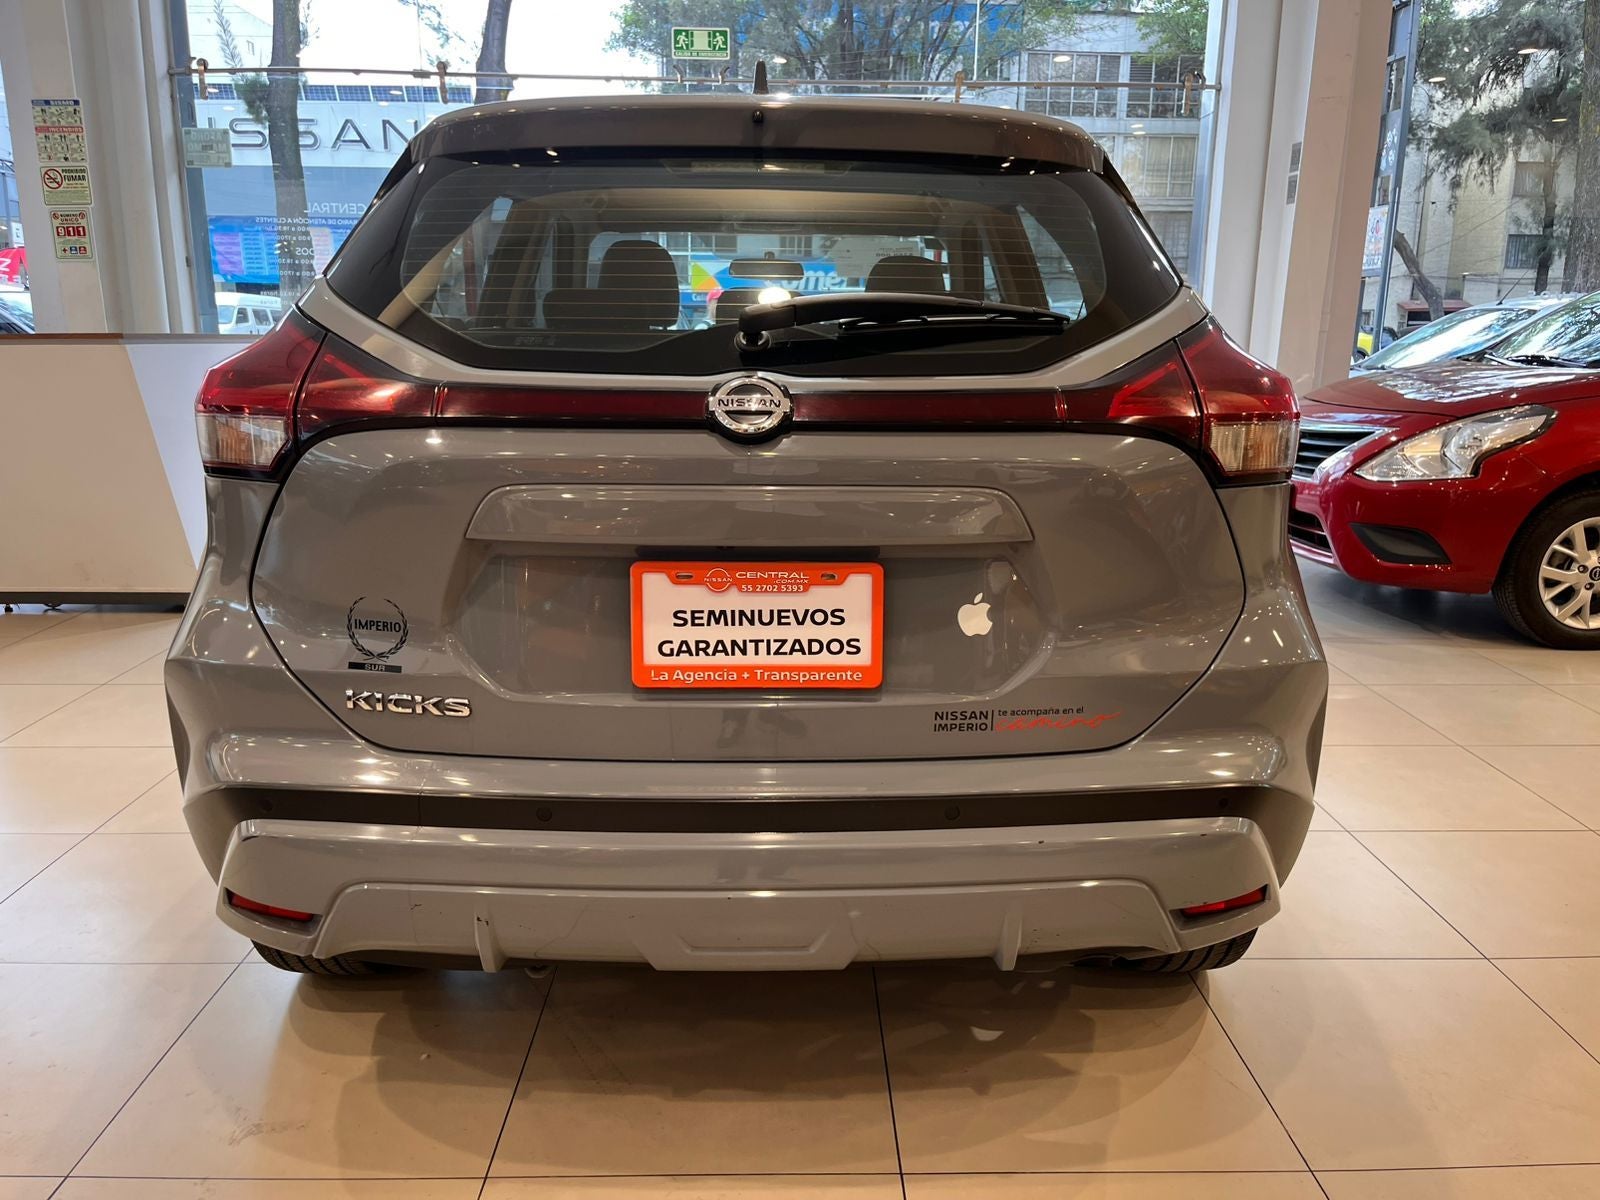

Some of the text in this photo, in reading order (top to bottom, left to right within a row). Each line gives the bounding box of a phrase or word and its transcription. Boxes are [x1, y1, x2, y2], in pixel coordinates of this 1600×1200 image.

[57, 226, 85, 236] 911
[717, 398, 781, 408] NISSAN
[736, 571, 809, 579] CENTRAL
[672, 608, 846, 627] SEMINUEVOS
[354, 618, 401, 633] IMPERIO
[657, 638, 862, 658] GARANTIZADOS
[364, 663, 386, 672] SUR
[651, 669, 669, 681] La
[673, 669, 738, 684] Agencia
[754, 669, 863, 684] Transparente
[345, 689, 471, 718] KICKS
[934, 710, 989, 721] NISSAN
[995, 712, 1122, 732] camino
[933, 722, 988, 732] IMPERIO
